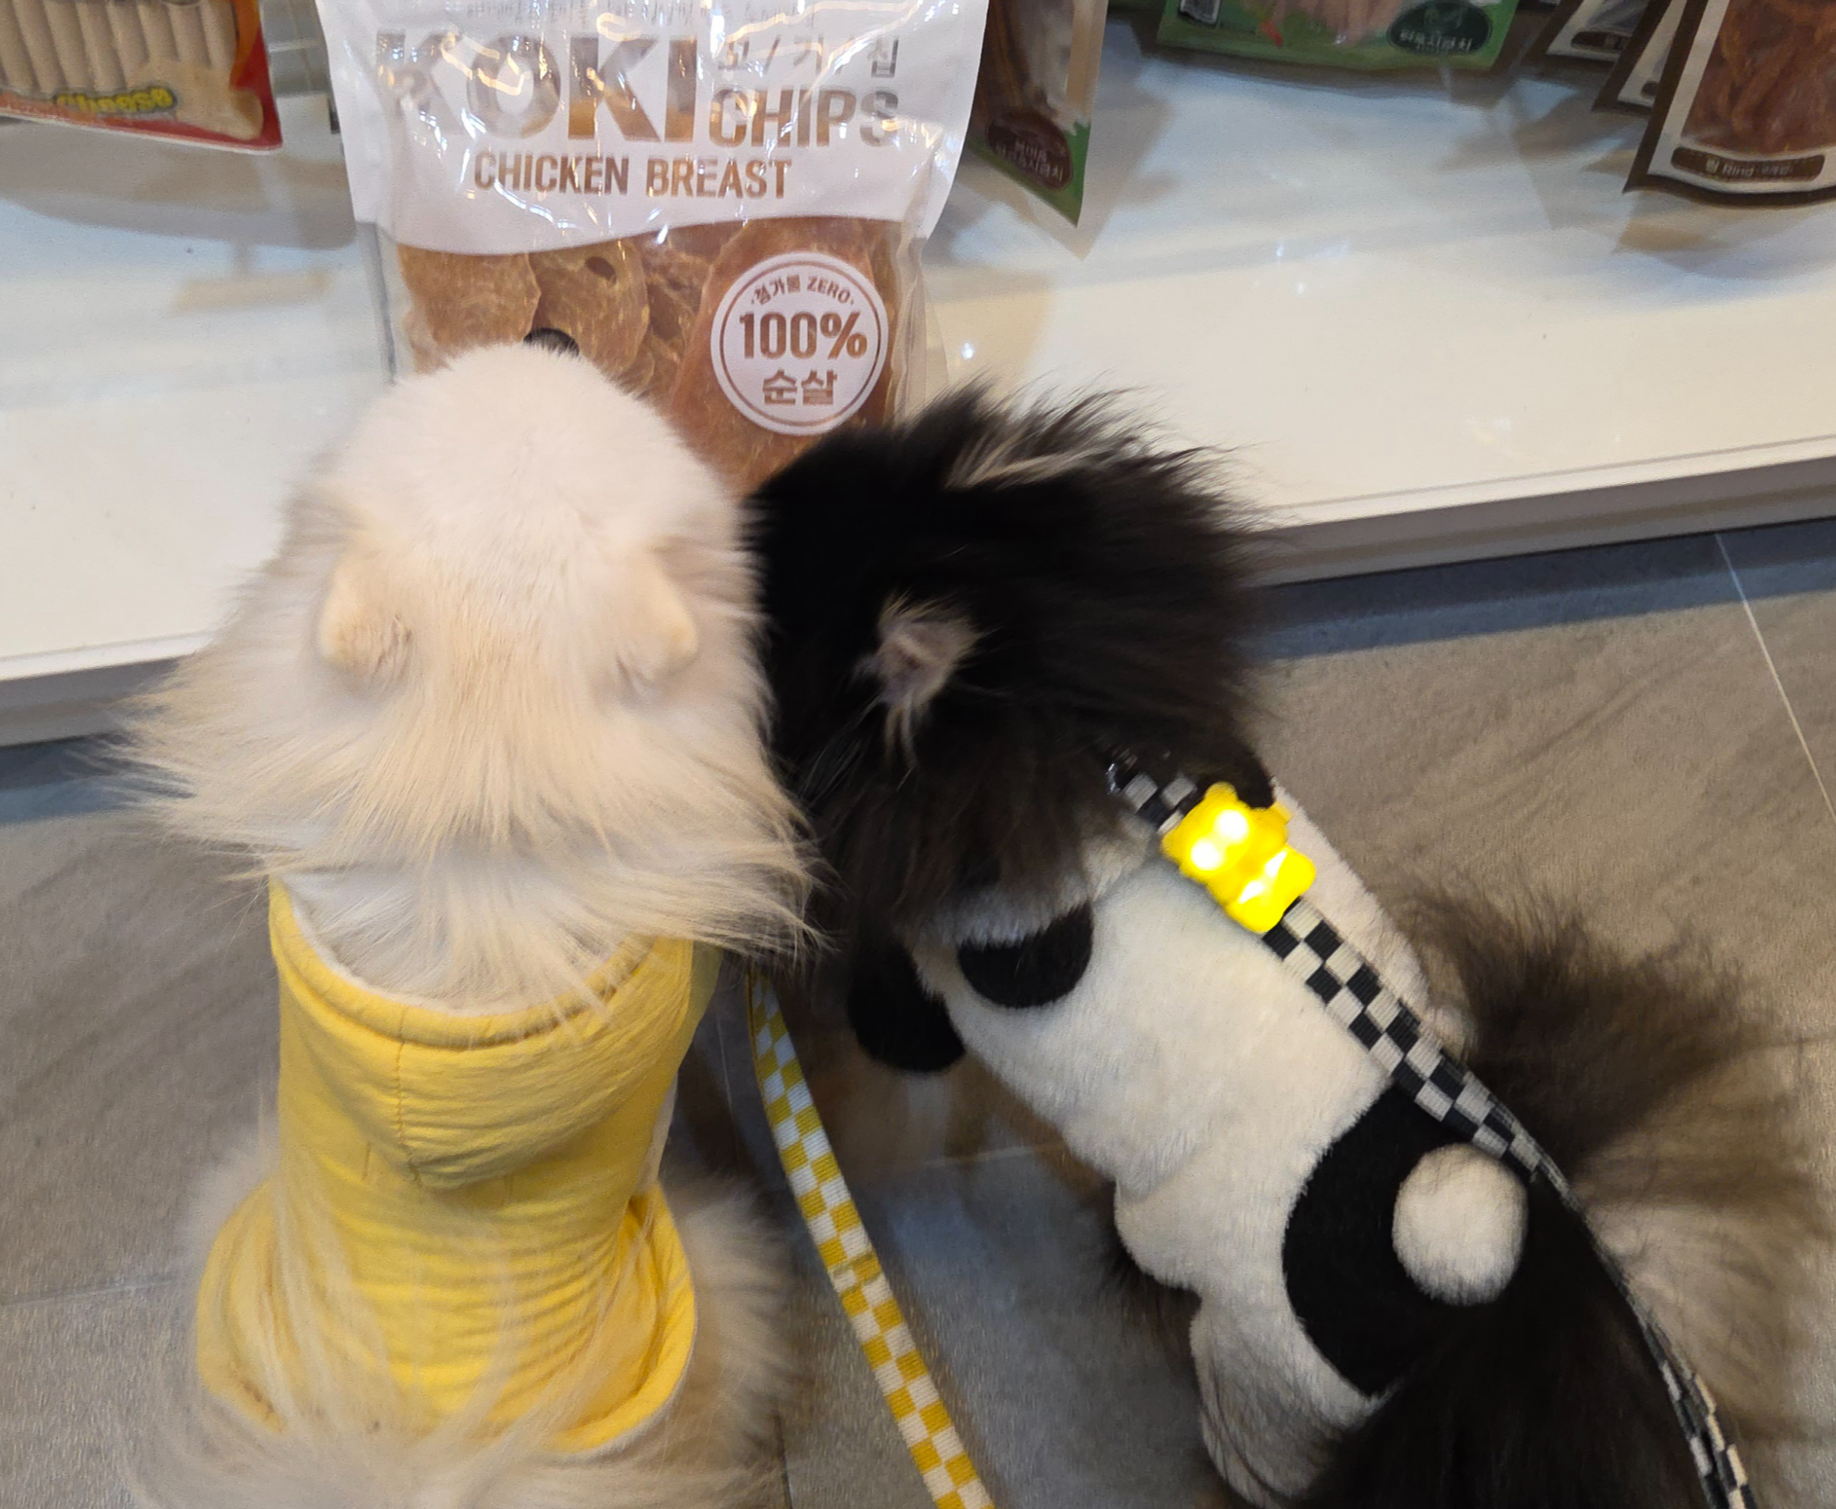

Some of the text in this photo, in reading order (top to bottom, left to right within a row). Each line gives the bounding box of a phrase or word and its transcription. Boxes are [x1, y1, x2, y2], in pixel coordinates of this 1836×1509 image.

[376, 32, 698, 142] KOKI
[709, 85, 900, 148] CHIPS
[474, 152, 793, 200] CHICKEN BREAST
[806, 276, 851, 304] ZERO
[740, 311, 868, 360] 100%
[762, 368, 838, 405] 순살
